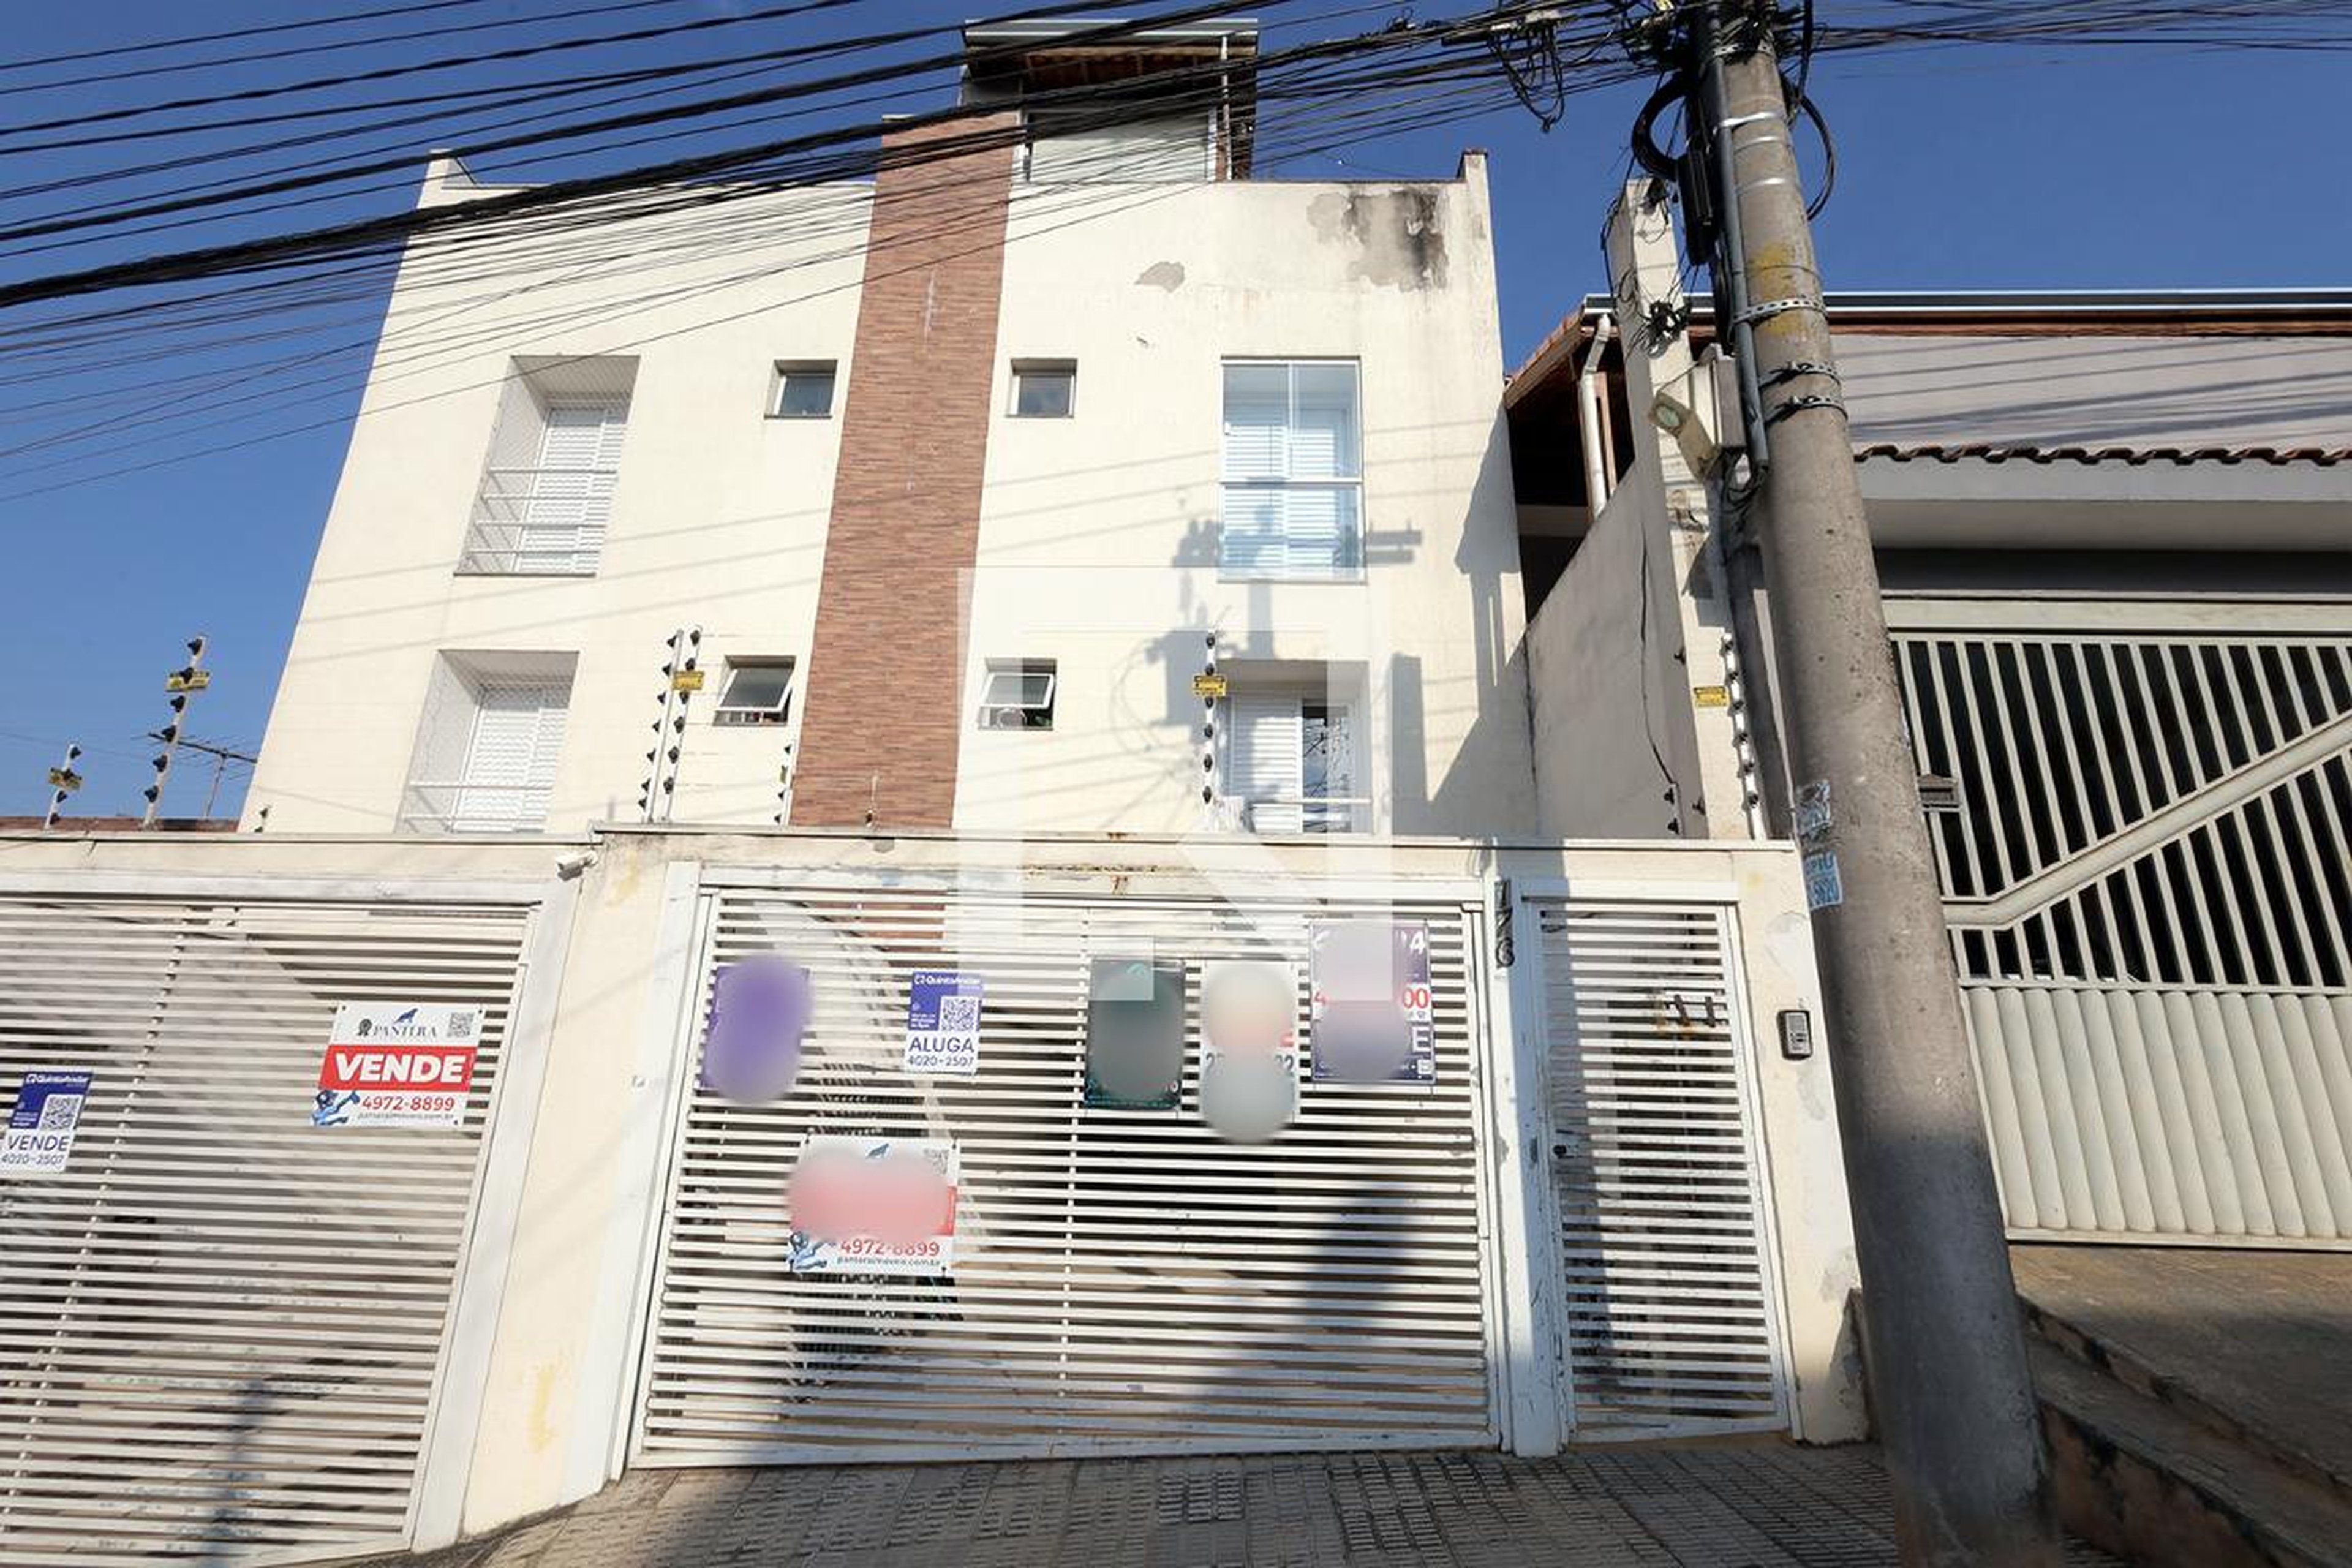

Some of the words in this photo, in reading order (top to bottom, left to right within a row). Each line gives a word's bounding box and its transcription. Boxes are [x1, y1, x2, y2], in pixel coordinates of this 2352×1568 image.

[908, 1037, 975, 1053] ALUGA
[334, 1053, 466, 1083] VENDE
[908, 1055, 974, 1067] 4020-2507
[362, 1096, 455, 1111] 4972-8899
[8, 1134, 70, 1152] VENDE
